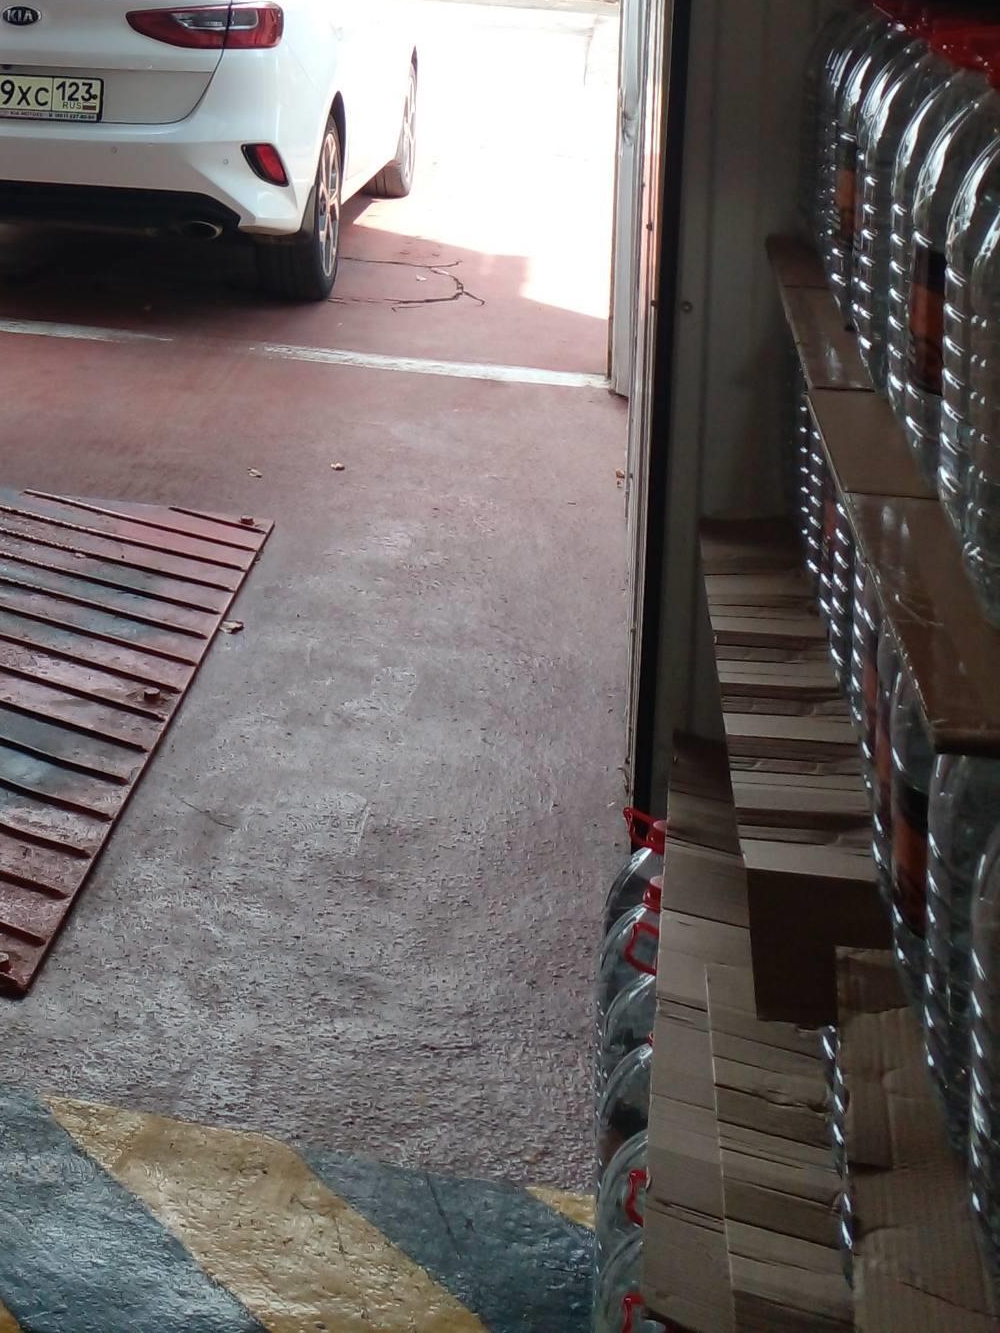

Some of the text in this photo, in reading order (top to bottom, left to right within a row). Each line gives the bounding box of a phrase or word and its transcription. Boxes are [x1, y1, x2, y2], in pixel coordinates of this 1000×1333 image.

[7, 9, 34, 22] KIA
[56, 81, 93, 102] 123
[62, 101, 82, 109] RUS
